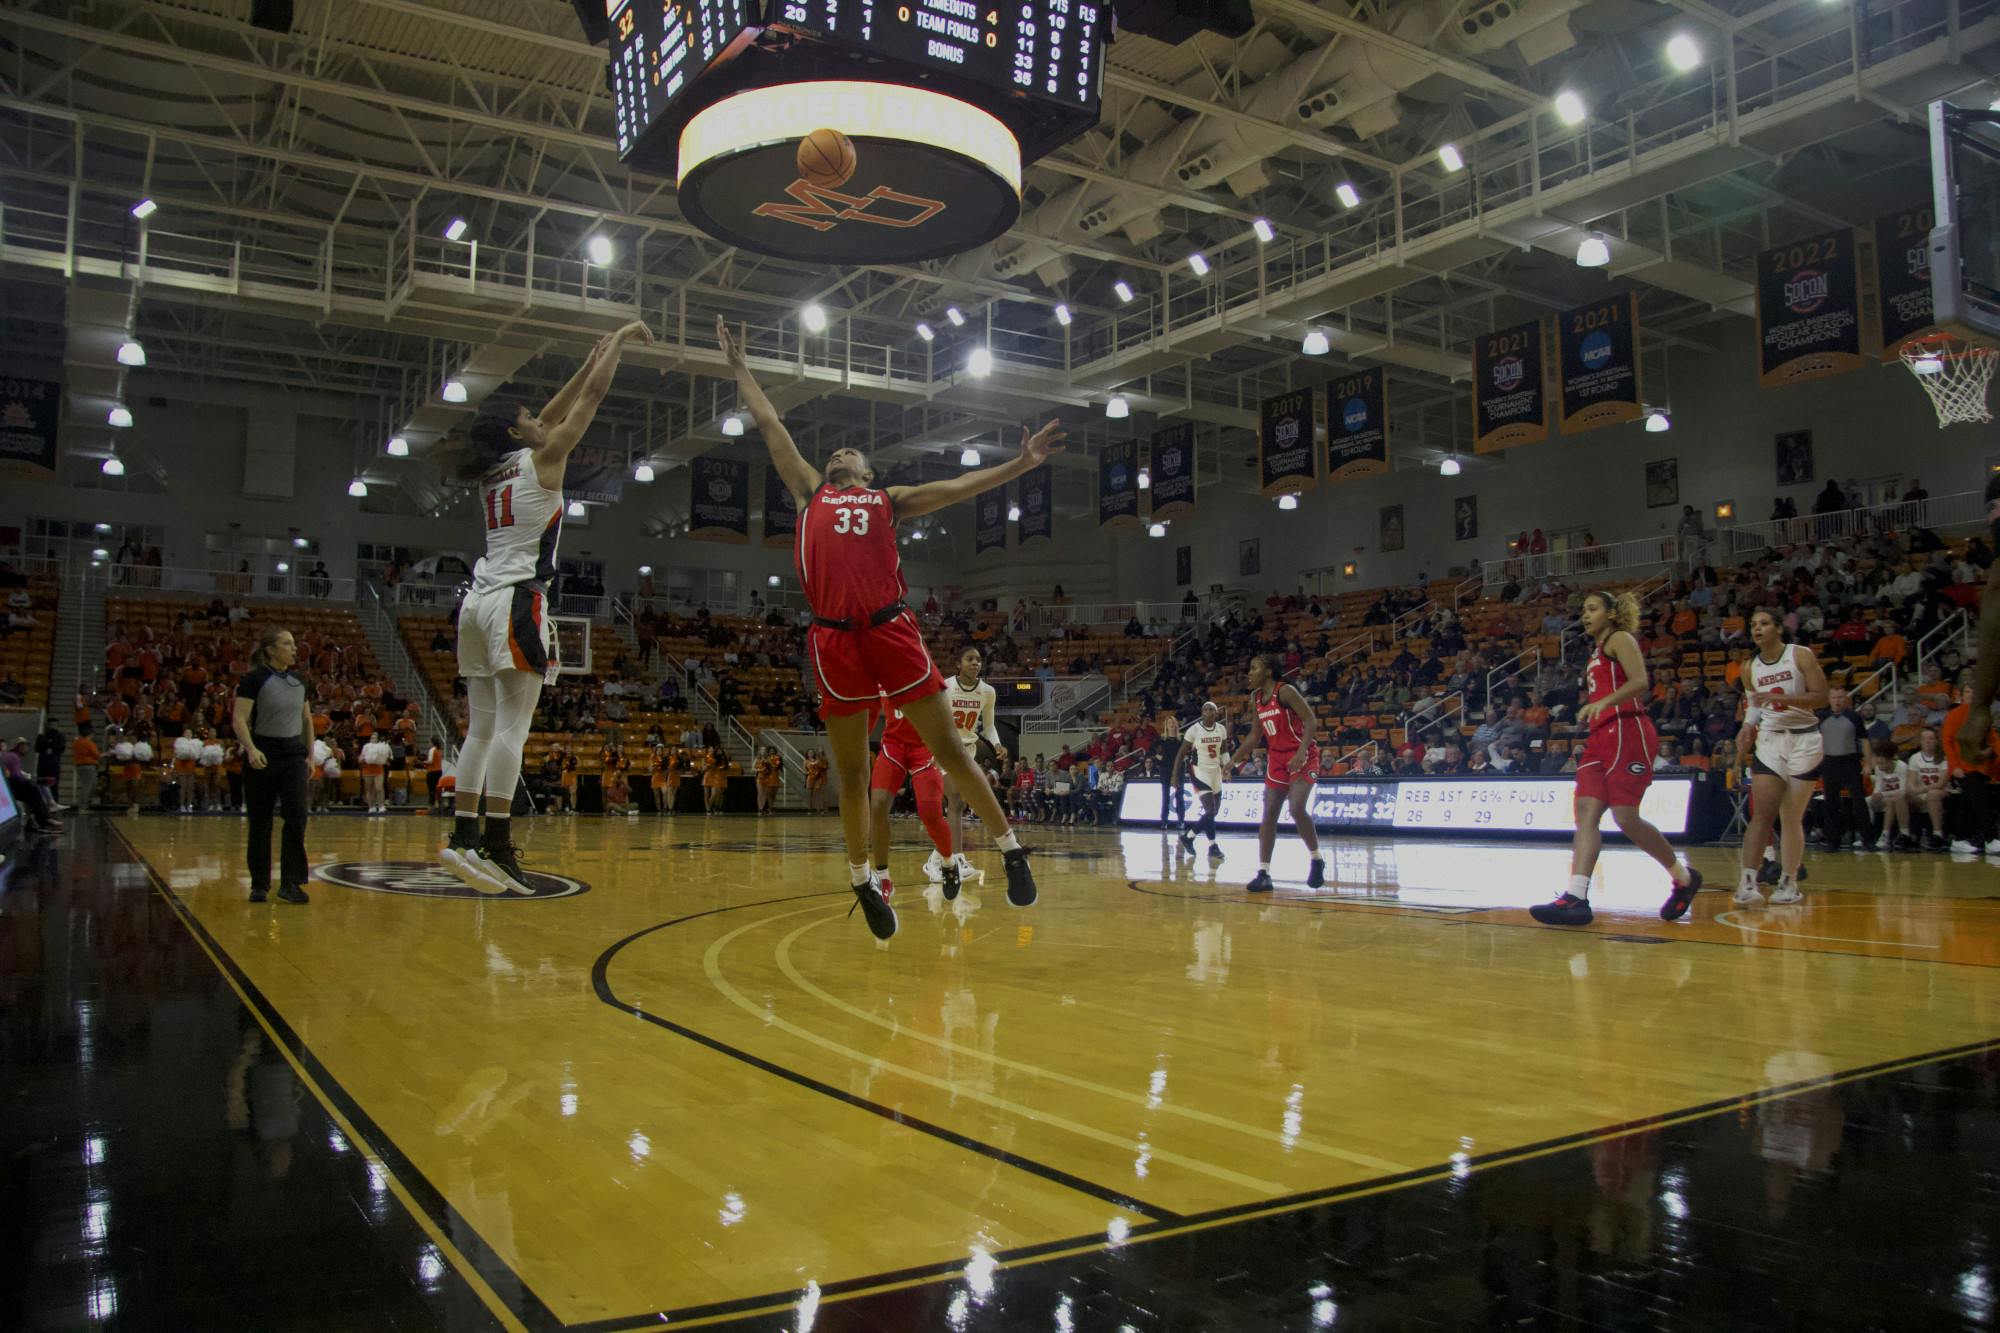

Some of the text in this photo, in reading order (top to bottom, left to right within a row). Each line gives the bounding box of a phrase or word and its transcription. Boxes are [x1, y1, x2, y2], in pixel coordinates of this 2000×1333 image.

[619, 9, 634, 42] 32
[784, 4, 806, 22] 20
[827, 17, 836, 31] 1
[863, 9, 872, 23] 1
[898, 6, 996, 48] 0 TEAM FOULS 0
[986, 11, 998, 26] 4
[1022, 5, 1090, 38] 0 10 1
[1079, 5, 1096, 23] FLS
[862, 26, 871, 40] 1
[1017, 21, 1089, 54] 10 8 2
[928, 40, 964, 64] BONUS
[1017, 37, 1088, 70] 11 0 1
[1014, 53, 1087, 85] 33 3 0
[1014, 70, 1086, 102] 35 8 1
[1772, 238, 1837, 273] 2022
[1784, 273, 1828, 307] SOCON
[1574, 304, 1618, 333] 2021
[1488, 332, 1528, 357] 2021
[1493, 359, 1523, 385] SOCON
[486, 484, 514, 529] 11
[834, 507, 869, 536] 33
[1757, 670, 1792, 687] MERCER
[1263, 720, 1276, 737] 10
[1208, 744, 1217, 759] 5
[1405, 790, 1431, 802] REB
[1438, 790, 1463, 802] AST
[1471, 790, 1502, 803] FG%
[1509, 790, 1556, 803] FOULS
[1407, 810, 1533, 825] 26 9 29 0
